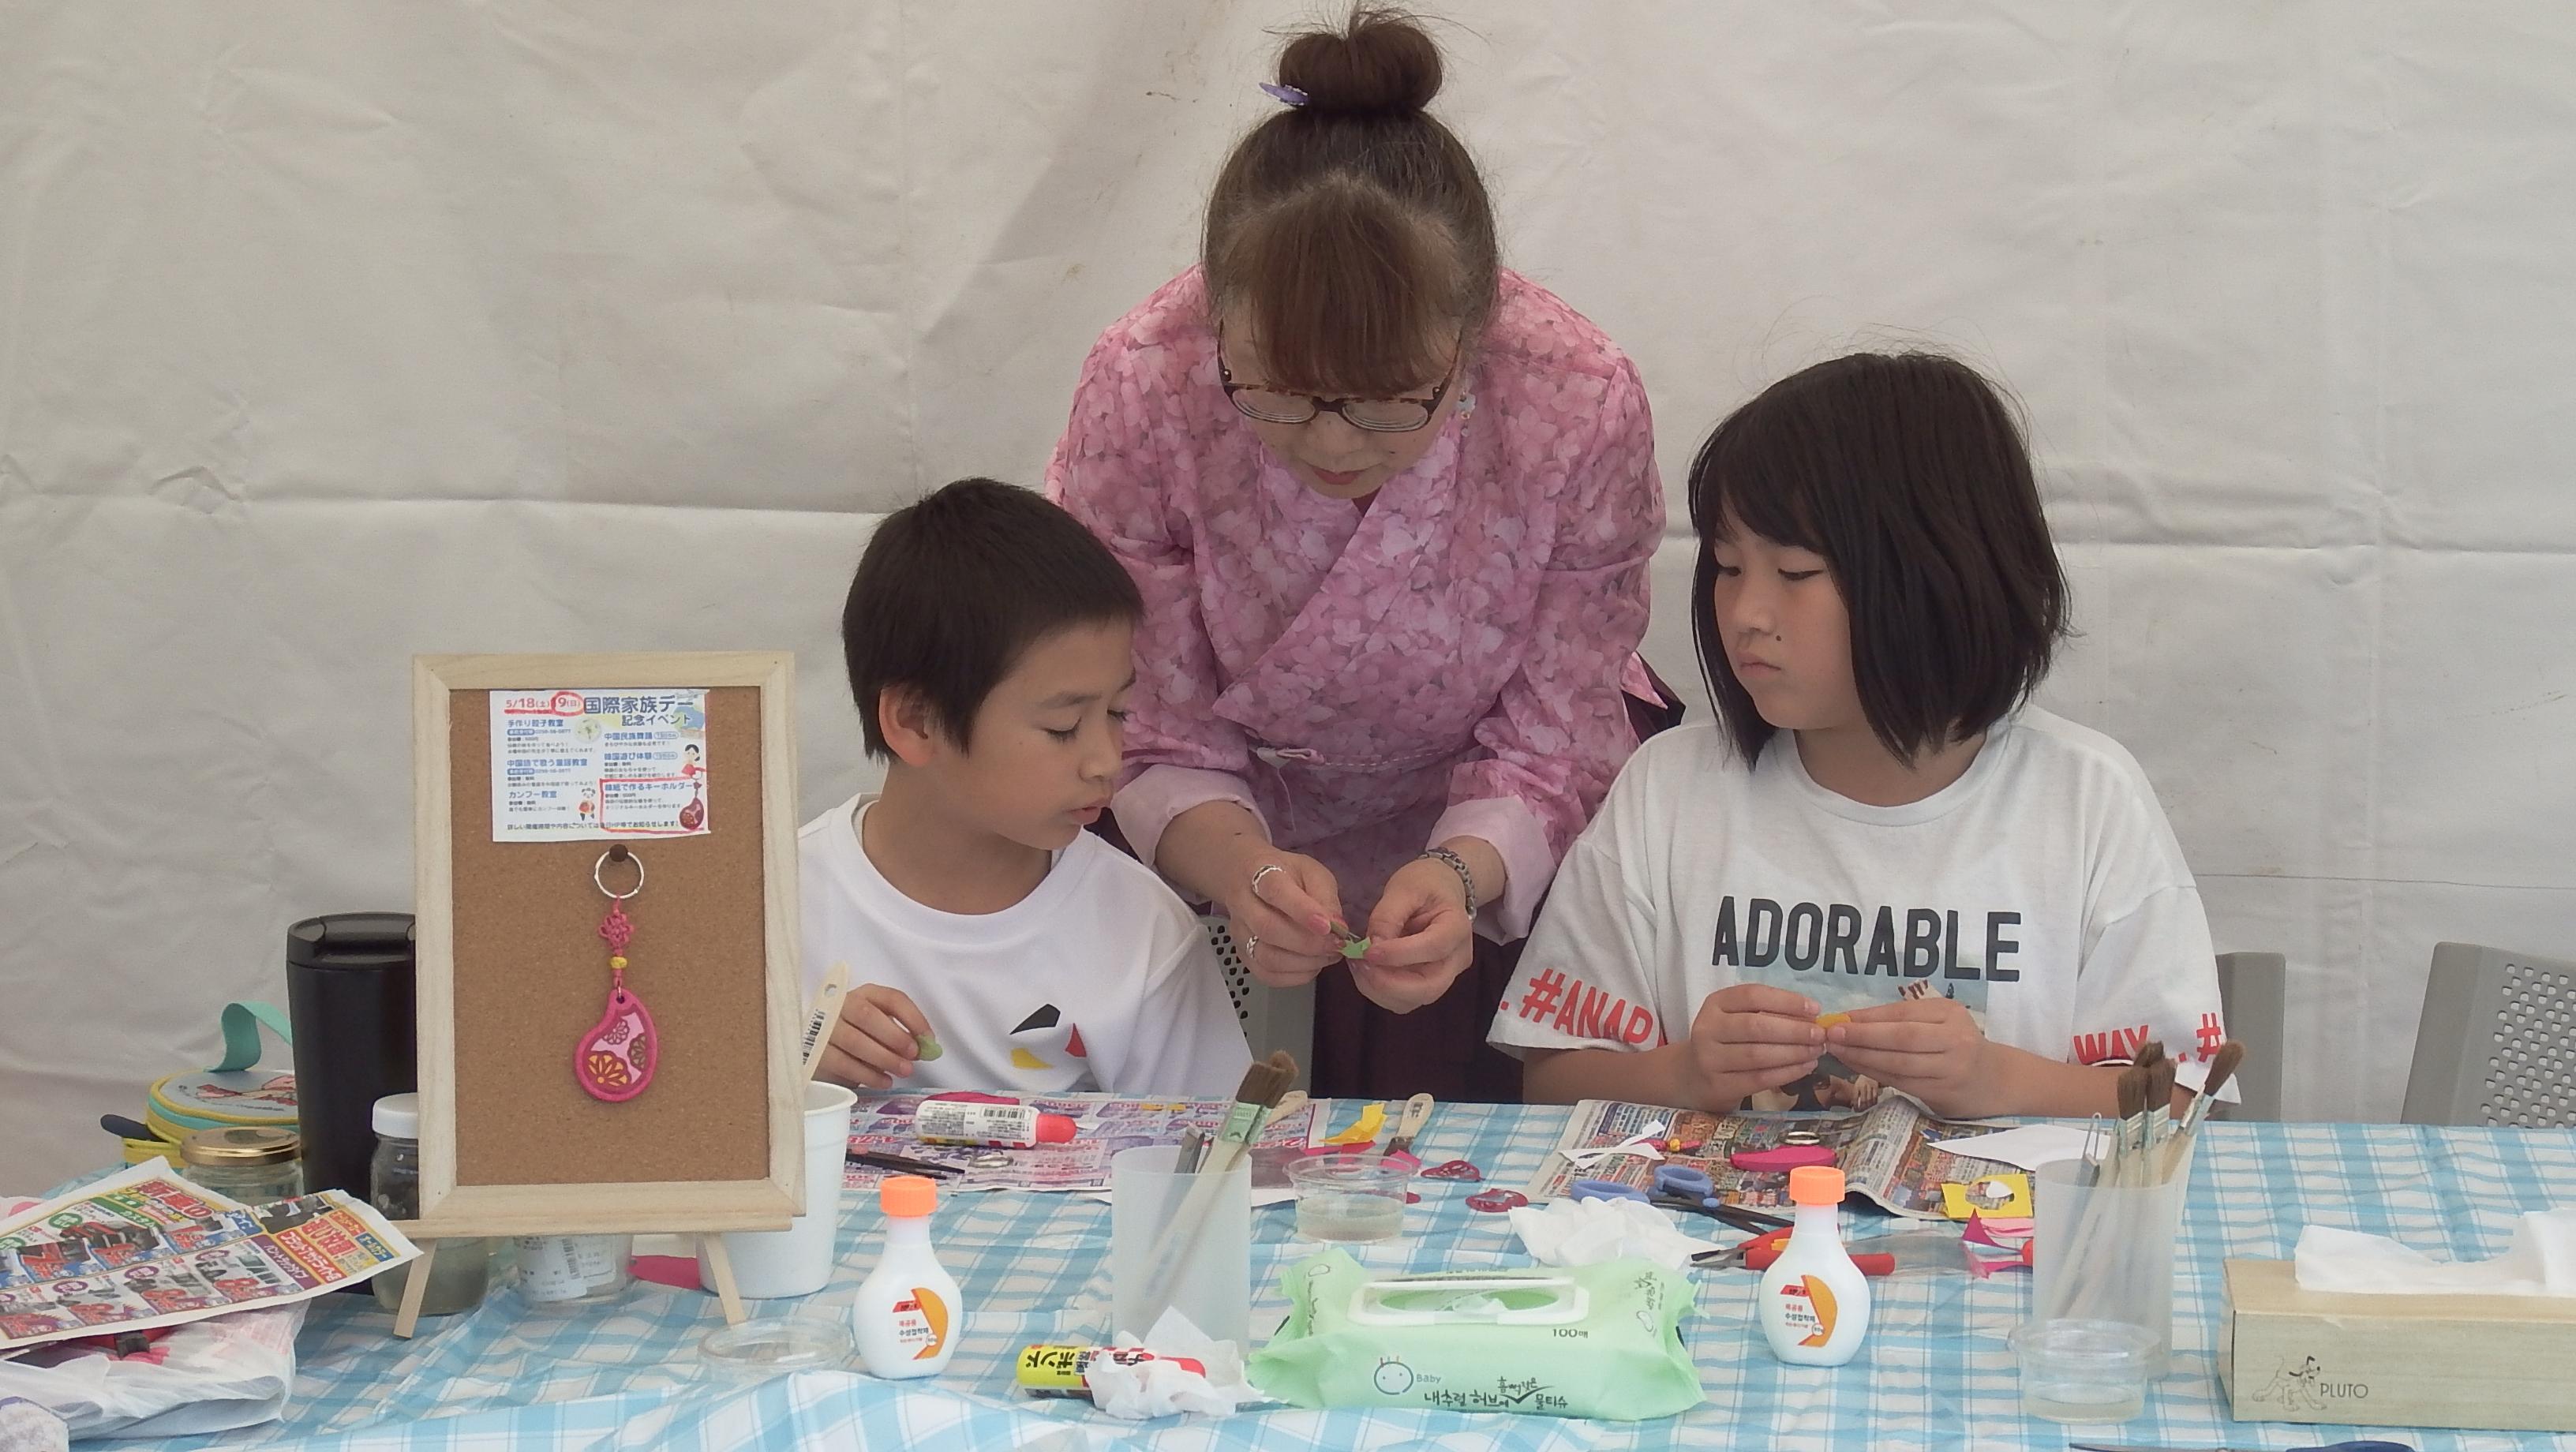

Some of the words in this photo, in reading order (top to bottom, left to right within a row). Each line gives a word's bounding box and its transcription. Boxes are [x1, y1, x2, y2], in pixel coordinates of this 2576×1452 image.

[584, 695, 694, 714] 国際家族デー
[621, 714, 691, 727] 記念イベント
[1712, 896, 2021, 982] ADORABLE
[1026, 1351, 1076, 1369] ボンド
[1416, 1374, 1441, 1384] Baby
[1424, 1389, 1466, 1407] 내추럴
[1534, 1393, 1569, 1410] 물티슈
[2320, 1382, 2369, 1399] PLUTO
